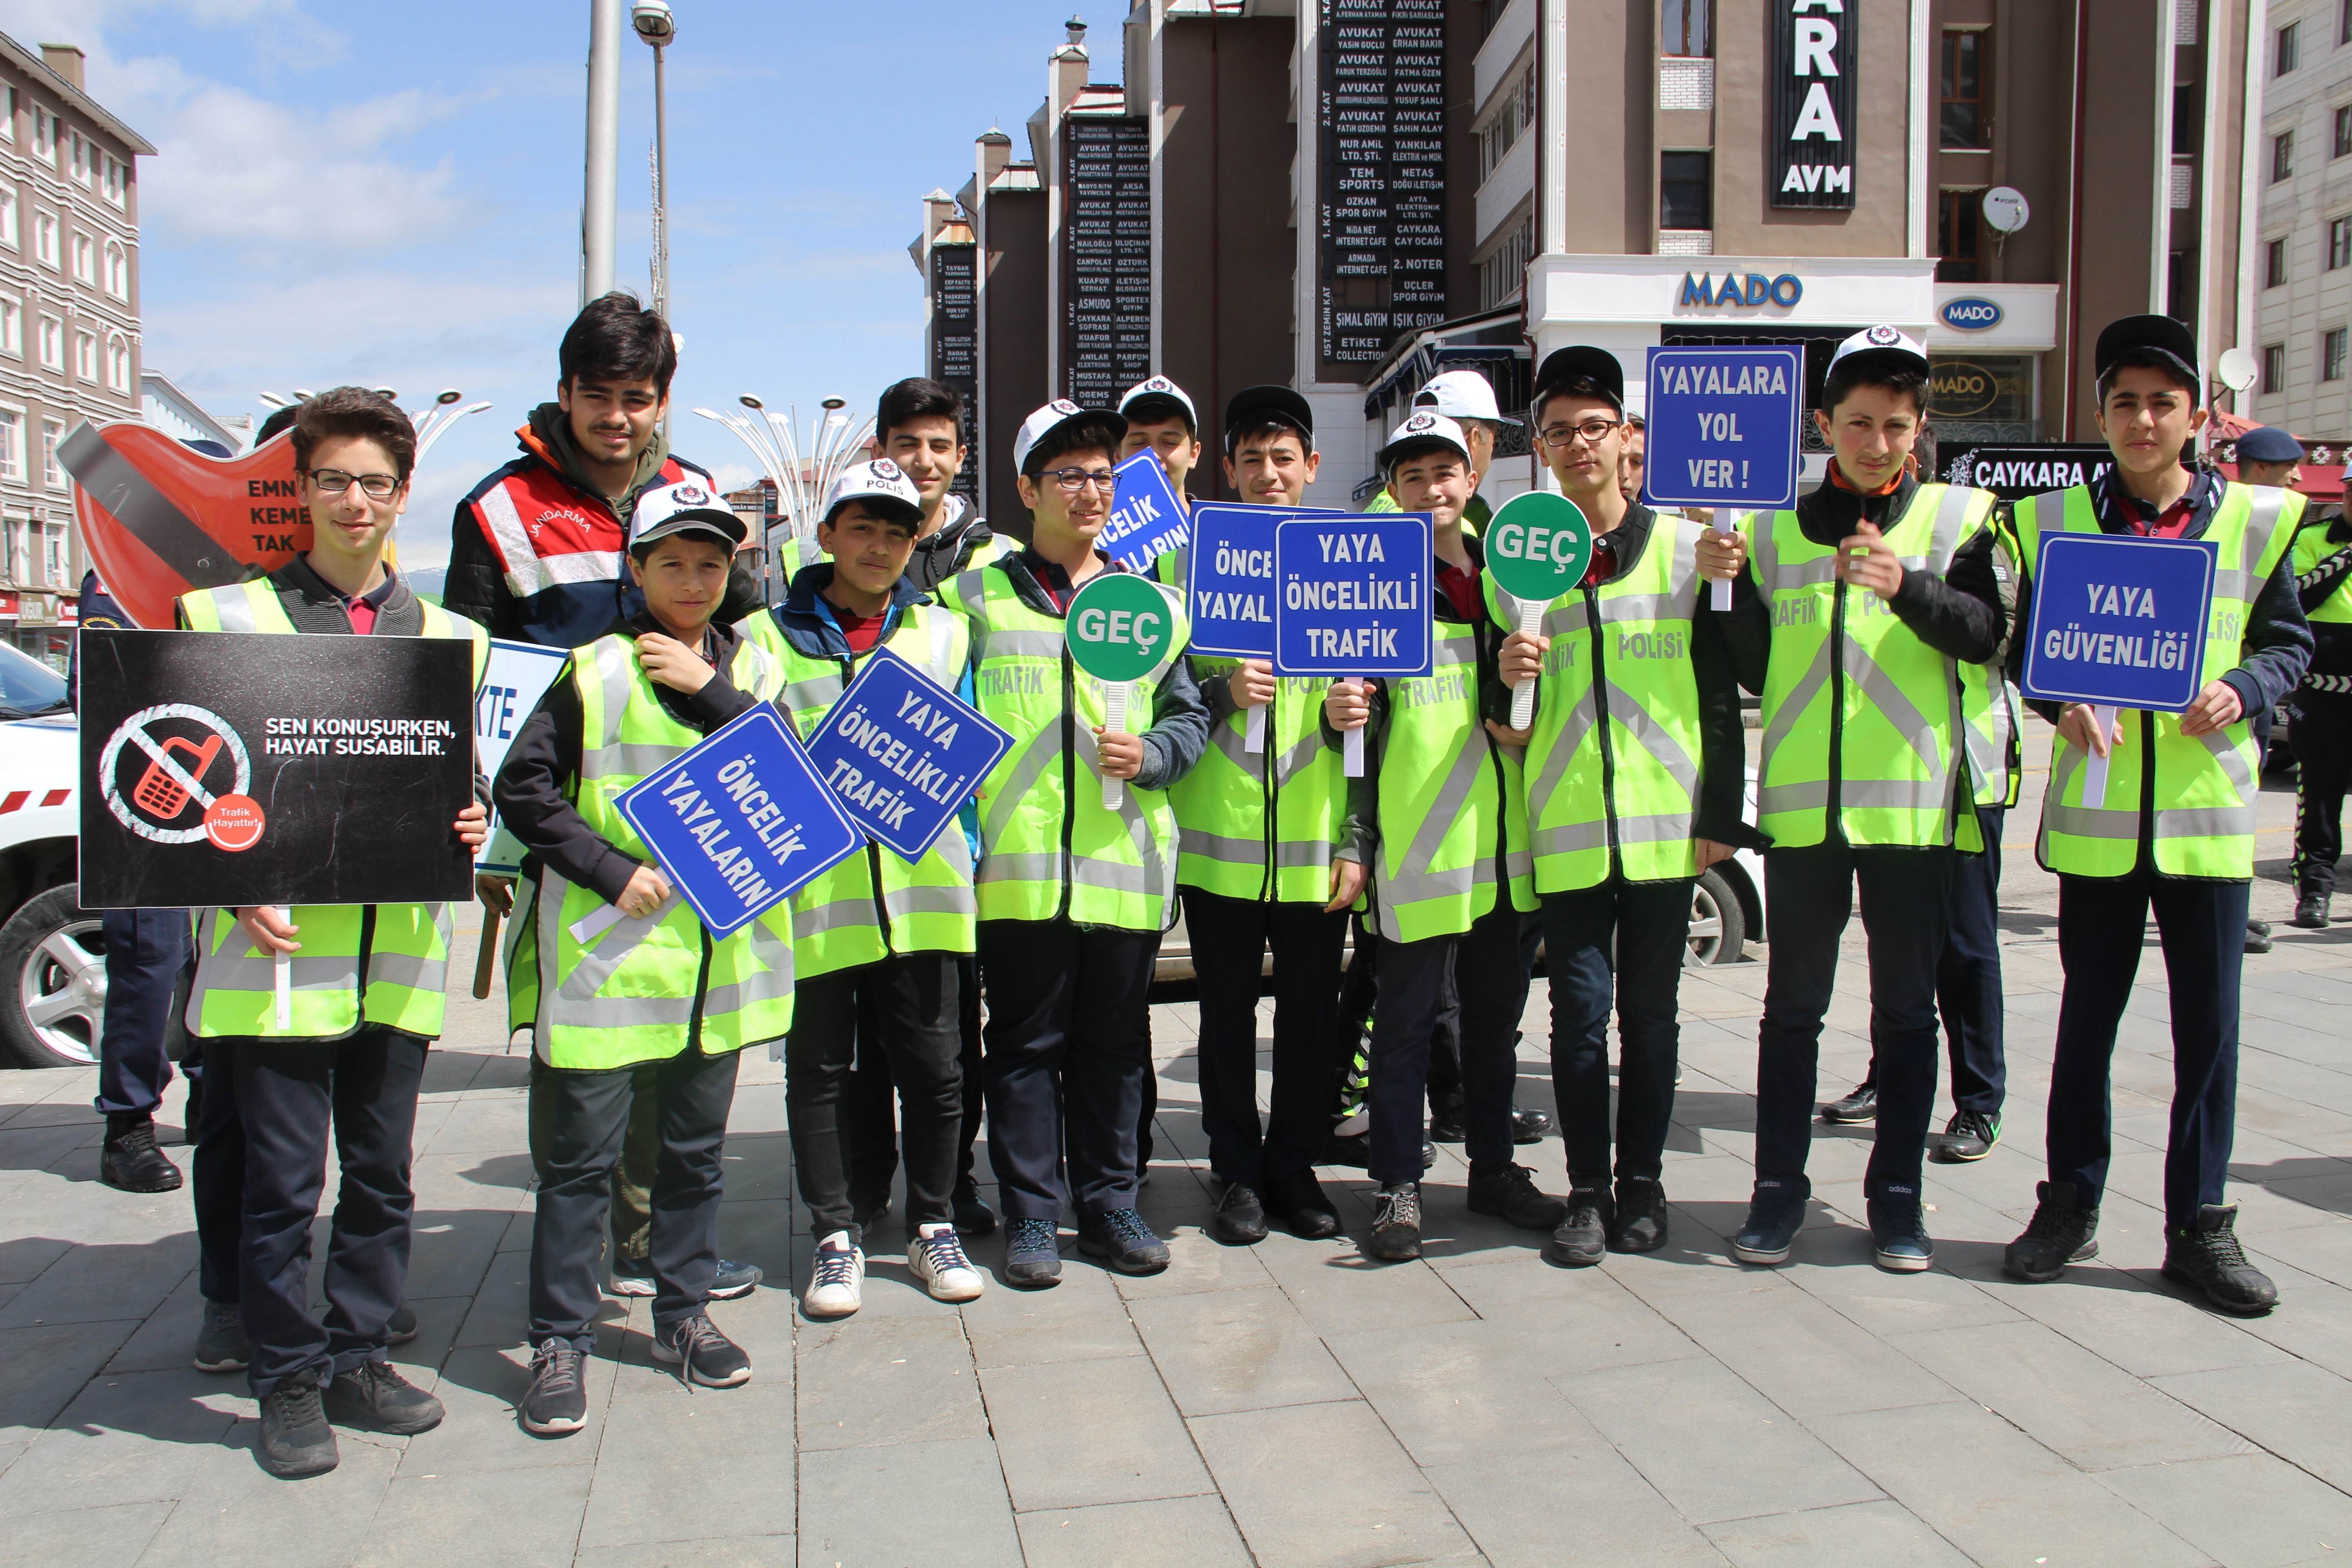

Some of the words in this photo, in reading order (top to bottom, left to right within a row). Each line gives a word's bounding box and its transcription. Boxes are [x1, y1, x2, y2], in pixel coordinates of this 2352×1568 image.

[1339, 0, 1384, 8] AVUKAT
[1396, 0, 1441, 9] AVUKAT
[1339, 28, 1384, 37] AVUKAT
[1396, 28, 1441, 37] AVUKAT
[1339, 55, 1384, 64] AVUKAT
[1396, 56, 1441, 64] AVUKAT
[1339, 83, 1384, 92] AVUKAT
[1396, 83, 1441, 92] AVUKAT
[1323, 91, 1331, 113] KAT
[1323, 117, 1331, 126] 2.
[1339, 112, 1384, 120] AVUKAT
[1396, 112, 1441, 120] AVUKAT
[1395, 141, 1441, 149] YANKILAR
[1343, 152, 1362, 160] LTD.
[1350, 168, 1373, 177] TEM
[1402, 169, 1433, 177] NETAŞ
[1782, 165, 1850, 192] AVM
[1340, 180, 1384, 189] SPORTS
[1323, 204, 1331, 225] KAT
[1323, 229, 1331, 238] 1.
[1397, 225, 1440, 233] ÇAYKARA
[1395, 237, 1412, 245] ÇAY
[1415, 236, 1442, 245] OCAĞI
[1394, 259, 1402, 269] 2.
[1406, 260, 1442, 269] NOTER
[1681, 271, 1803, 307] MADO
[1078, 299, 1110, 309] ASMUDO
[1394, 314, 1413, 328] IŞIK
[1949, 307, 1994, 320] MADO
[1660, 367, 1786, 394] YAYALARA
[1930, 376, 1984, 394] MADO
[1698, 413, 1742, 441] YOL
[1688, 460, 1733, 488] VER
[1975, 461, 2085, 489] ÇAYKARA
[529, 510, 590, 537] JANDARMA
[252, 535, 295, 551] TAK
[1318, 534, 1385, 562] YAYA
[1495, 524, 1578, 574] GEÇ
[1287, 573, 1416, 610] ÖNCELİKLİ
[1196, 592, 1272, 623] YAYAL
[2087, 584, 2155, 618] YAYA
[1077, 608, 1160, 656] GEÇ
[1306, 621, 1399, 658] TRAFİK
[2044, 623, 2188, 671] GÜVENLİĞİ
[266, 718, 307, 735] SEN
[314, 719, 456, 740] KONUŞURKEN,
[896, 690, 960, 751] YAYA
[266, 738, 330, 755] HAYAT
[336, 736, 446, 755] SUSABİLİR.
[838, 706, 966, 806] ÖNCELİKLİ
[827, 758, 915, 832] TRAFİK
[716, 754, 808, 866] ÖNCELİK
[214, 818, 258, 828] Hayattır!
[661, 770, 773, 908] YAYALARIN
